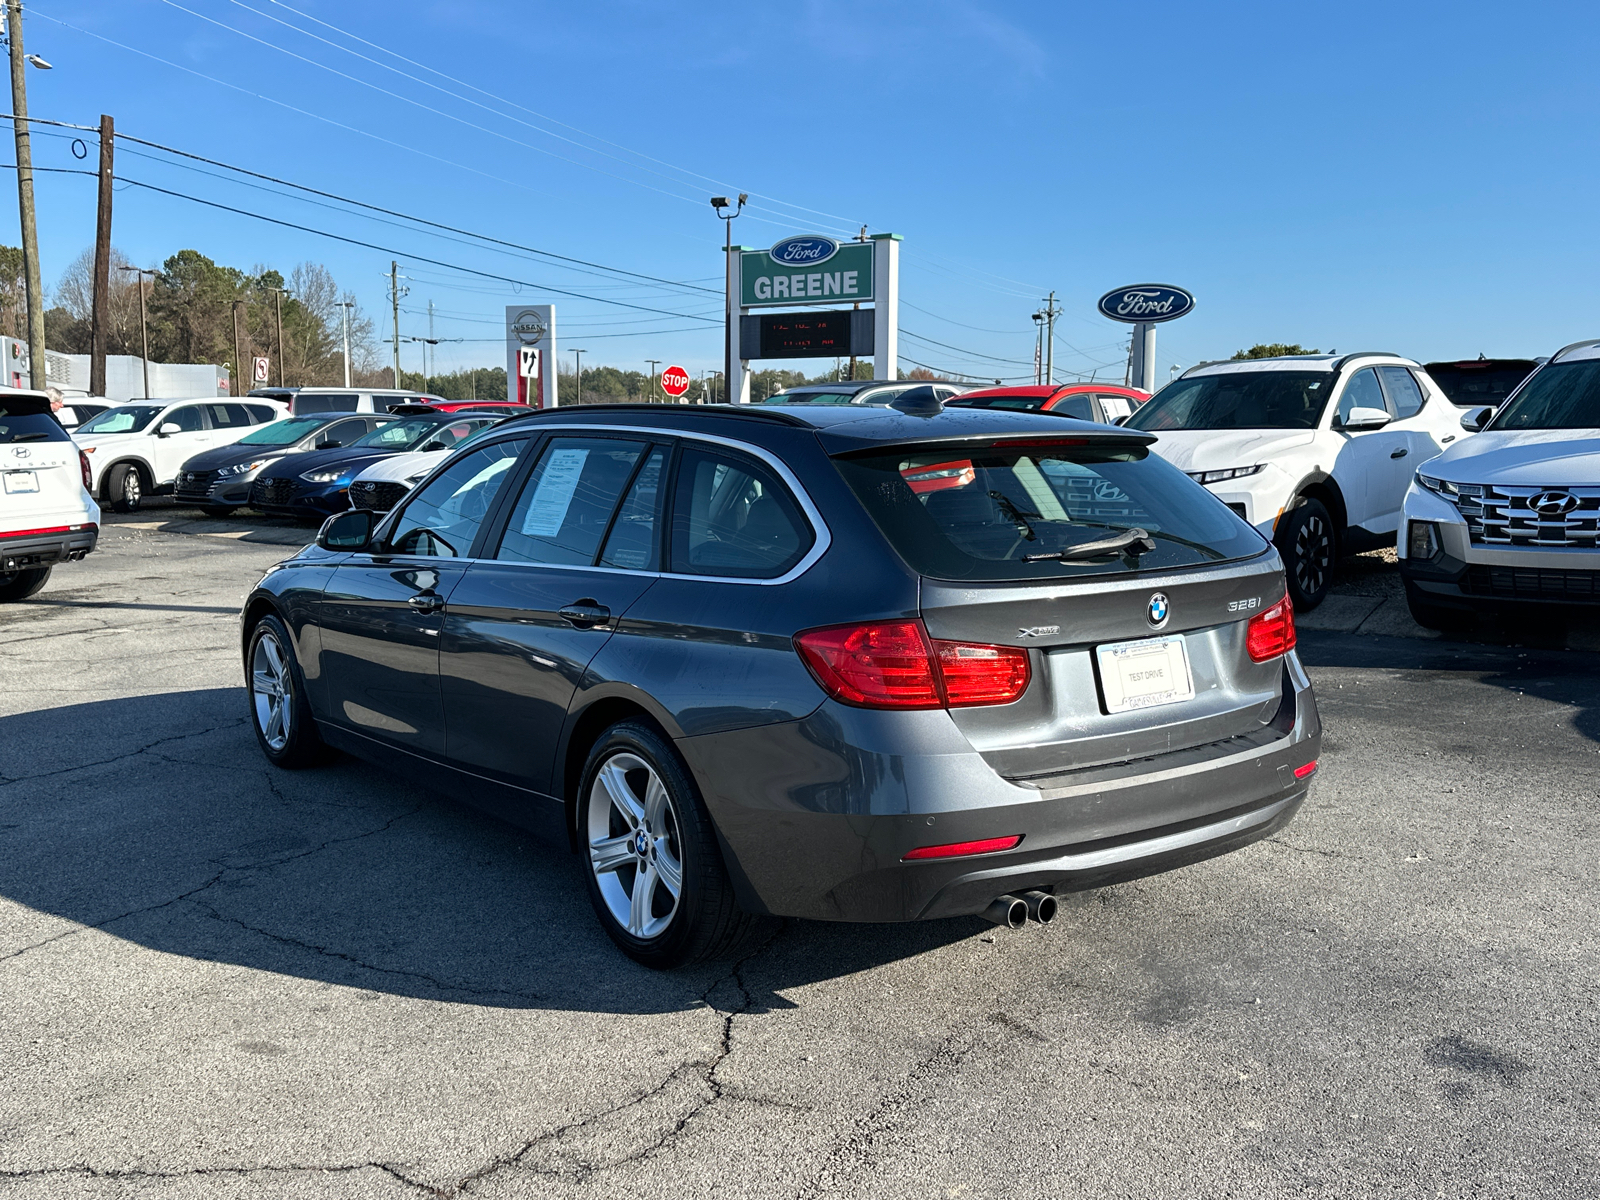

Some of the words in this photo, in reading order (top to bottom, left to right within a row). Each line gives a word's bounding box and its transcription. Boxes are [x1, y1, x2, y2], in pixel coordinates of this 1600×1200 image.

[783, 241, 821, 260] Ford
[754, 270, 859, 300] GREENE
[1117, 290, 1175, 315] Ford
[513, 323, 543, 332] NISSAN
[662, 373, 688, 388] STOP
[1128, 671, 1144, 682] TEST
[1144, 668, 1164, 680] DRIVE
